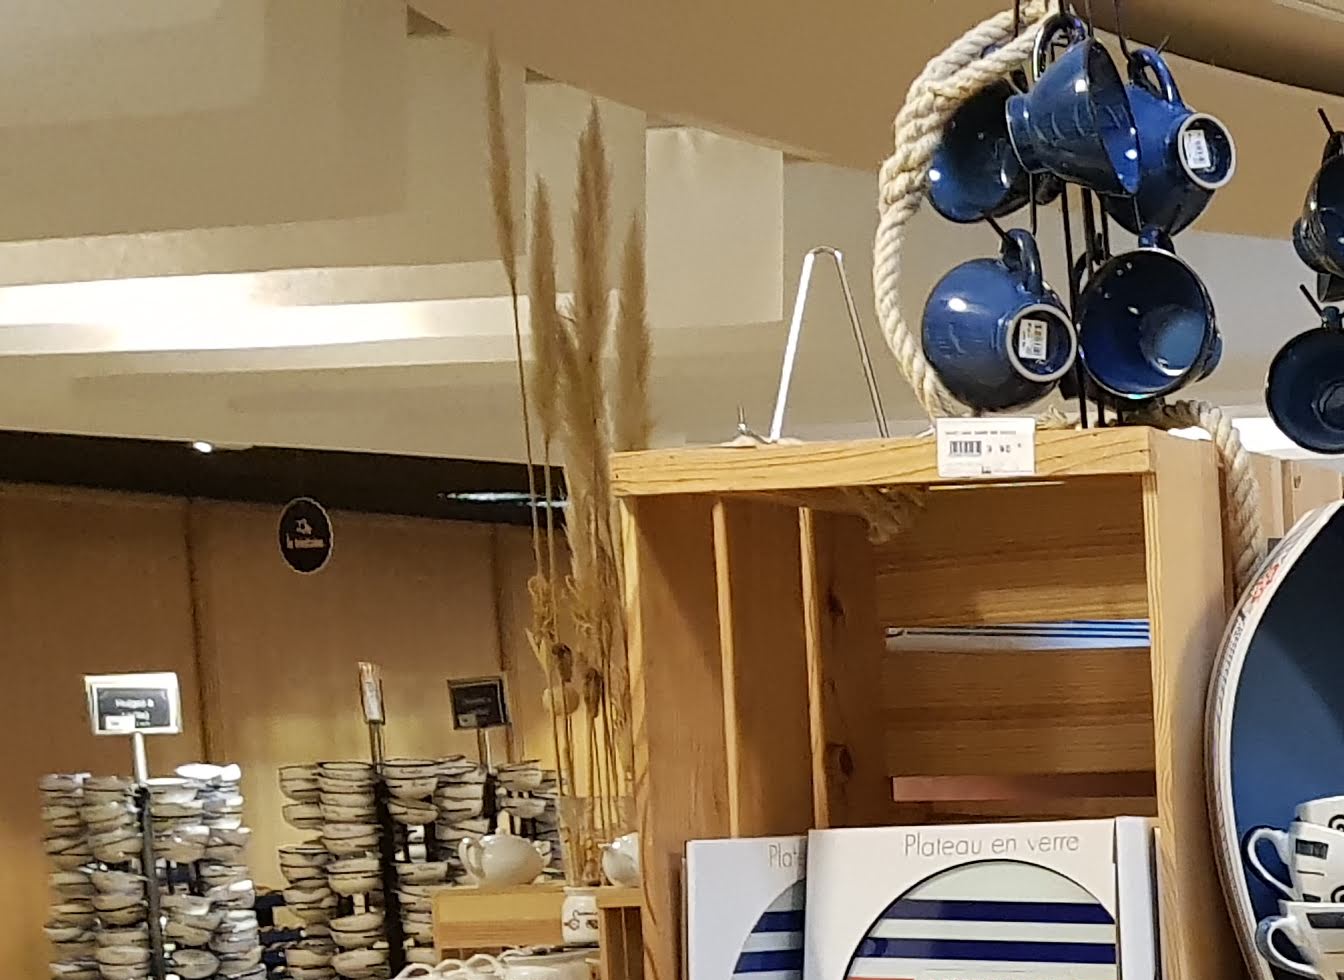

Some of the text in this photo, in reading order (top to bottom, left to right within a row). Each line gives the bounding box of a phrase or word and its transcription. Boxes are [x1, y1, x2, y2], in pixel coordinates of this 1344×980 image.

[769, 843, 806, 868] Plat
[905, 832, 1079, 857] Plateau en verre
